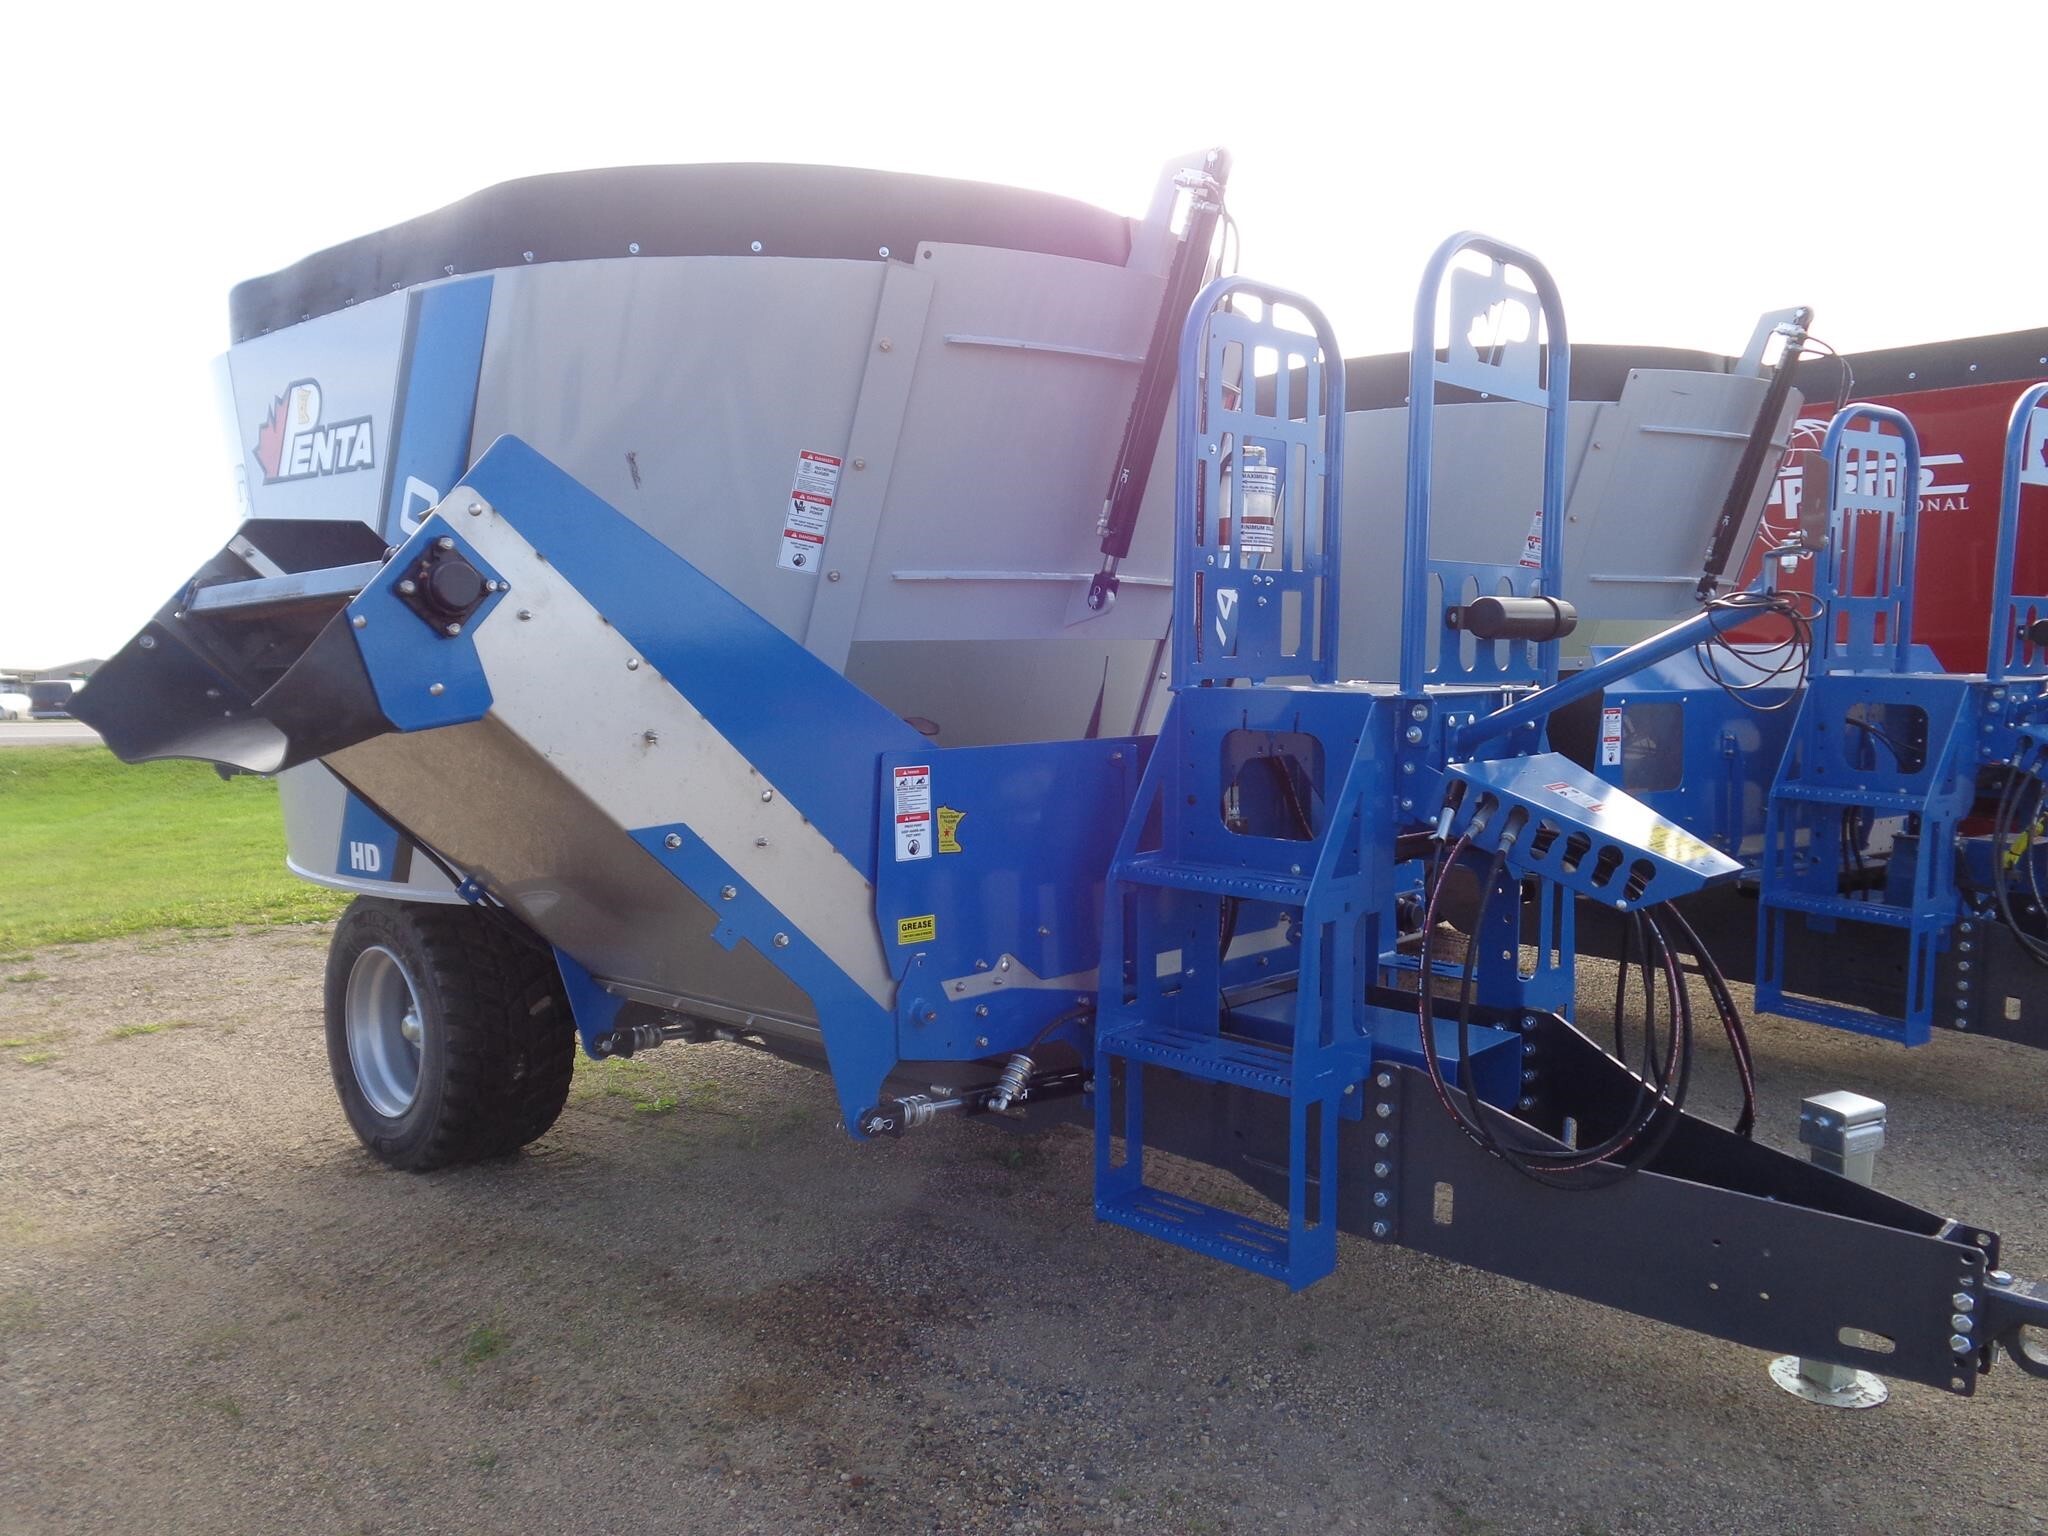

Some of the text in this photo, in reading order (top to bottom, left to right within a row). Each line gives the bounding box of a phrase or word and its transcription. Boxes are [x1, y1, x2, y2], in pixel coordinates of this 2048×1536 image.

[277, 379, 374, 480] PENTA
[350, 841, 380, 872] HD
[902, 920, 932, 931] GREASE
